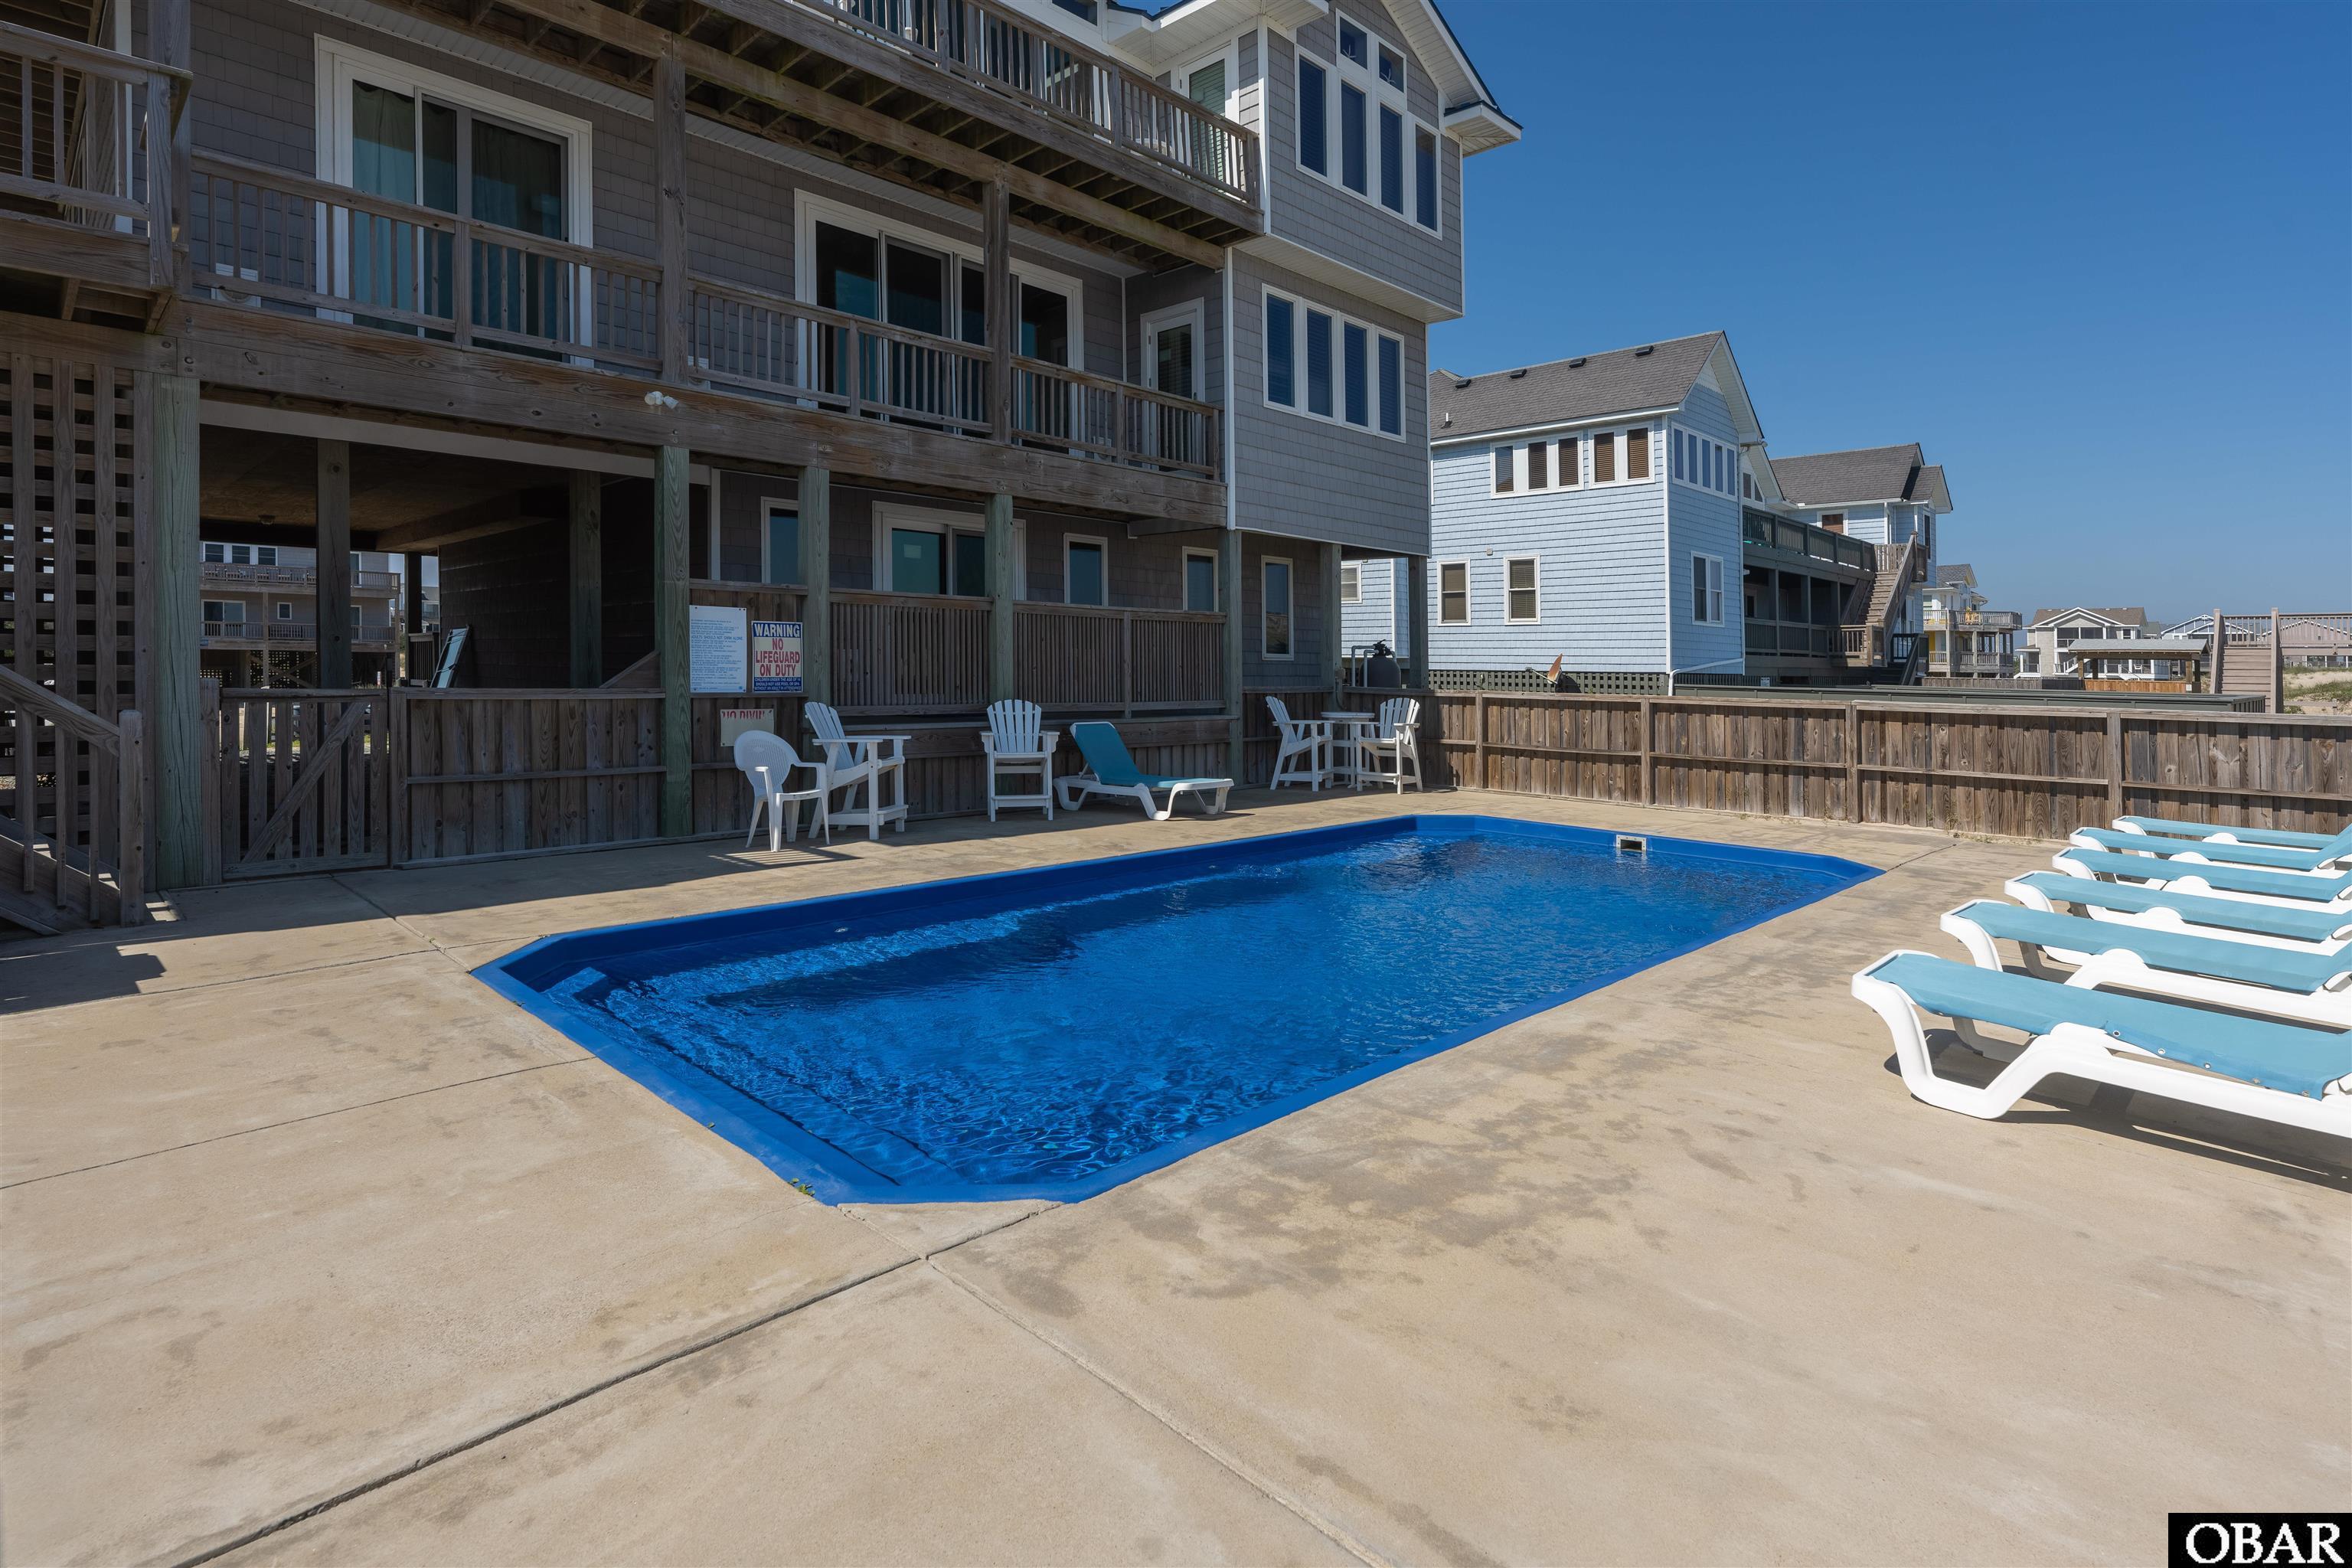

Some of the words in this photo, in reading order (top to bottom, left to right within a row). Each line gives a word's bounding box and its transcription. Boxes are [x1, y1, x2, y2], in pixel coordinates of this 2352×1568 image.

[754, 623, 800, 637] WARNING
[772, 638, 783, 650] NO
[755, 651, 800, 664] LIFEGUARD
[760, 664, 771, 676] ON
[776, 664, 796, 676] DUTY
